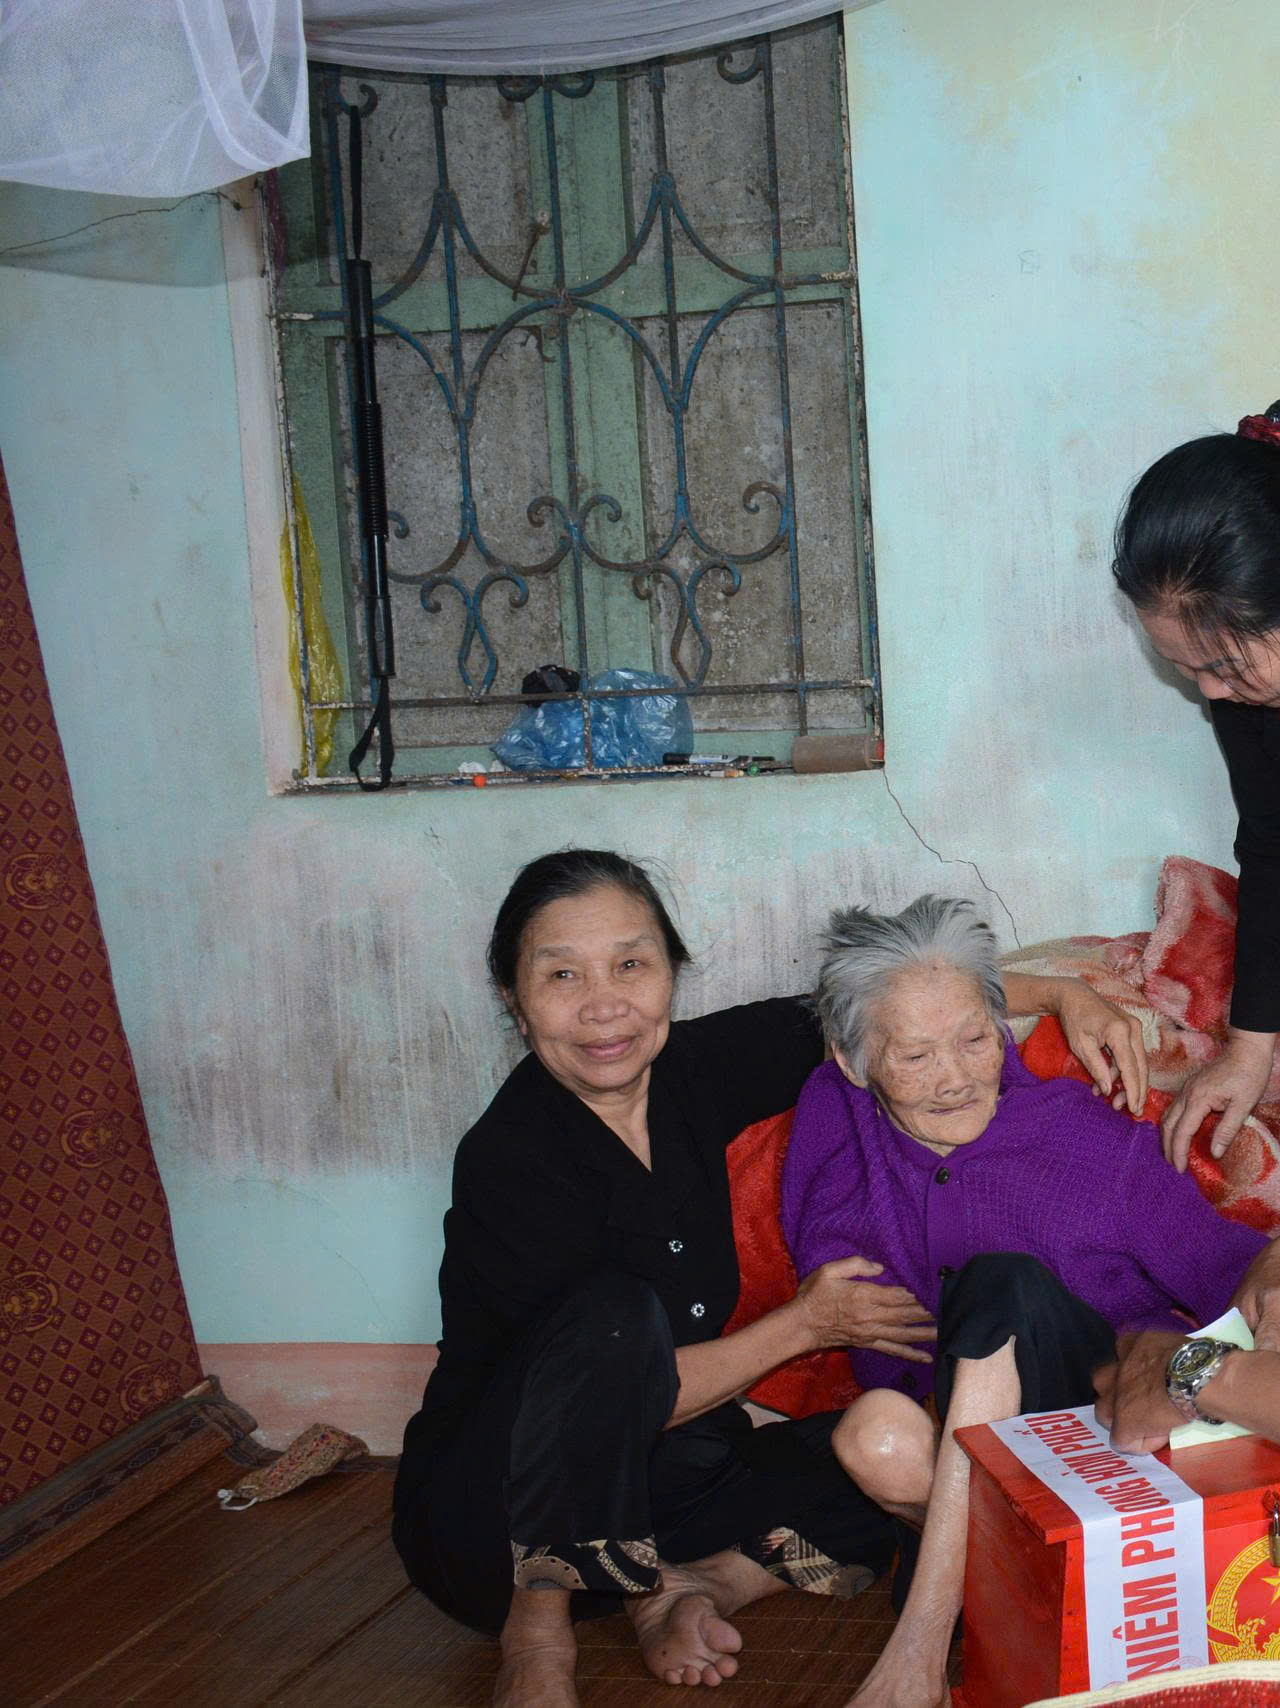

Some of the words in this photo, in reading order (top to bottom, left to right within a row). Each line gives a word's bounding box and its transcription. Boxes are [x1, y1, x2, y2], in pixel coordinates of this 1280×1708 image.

[1013, 1412, 1105, 1456] PHIẾU
[1061, 1450, 1138, 1484] HÒM
[1095, 1477, 1175, 1568] PHONG
[1112, 1573, 1180, 1681] NIÊM
